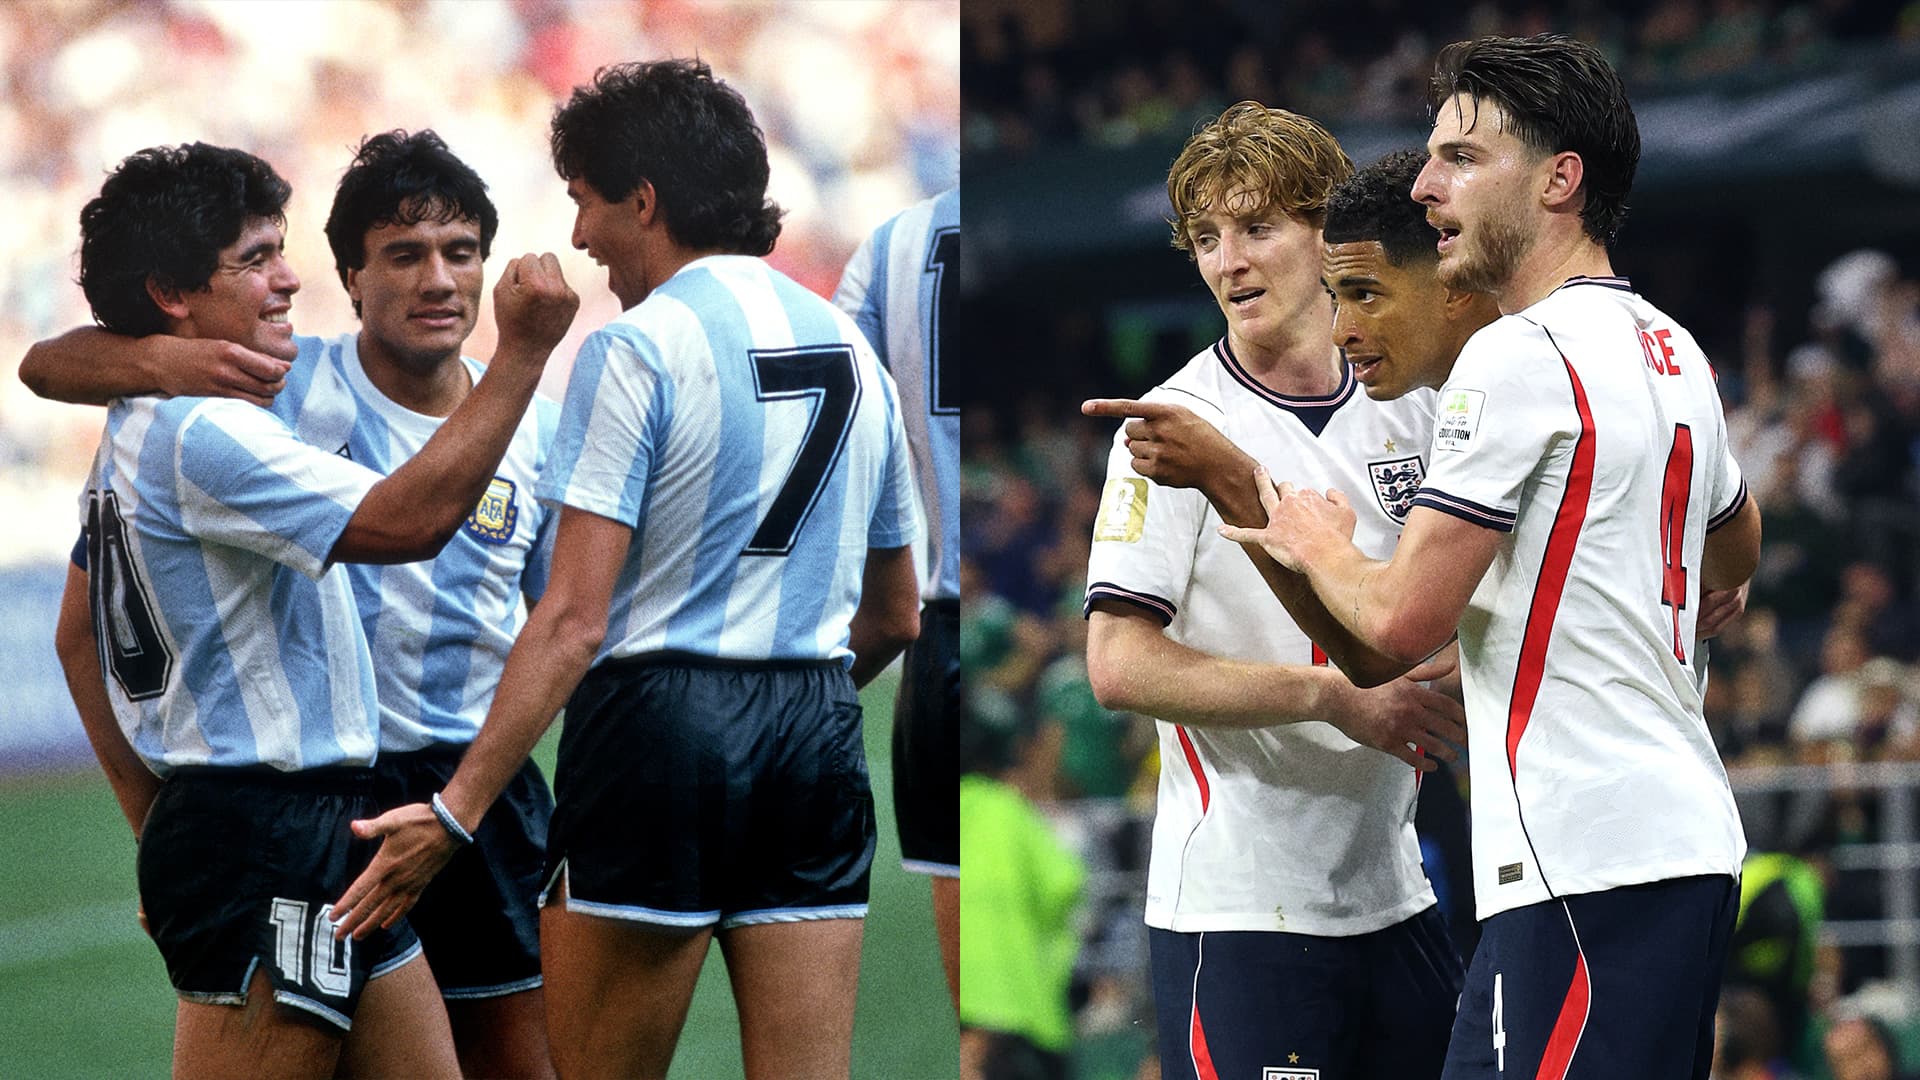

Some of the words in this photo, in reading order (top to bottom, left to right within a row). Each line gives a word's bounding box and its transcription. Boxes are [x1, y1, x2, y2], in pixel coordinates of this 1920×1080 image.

[480, 497, 503, 521] AFA
[739, 344, 863, 556] 7
[87, 489, 174, 703] 10
[1660, 423, 1693, 664] 4
[269, 896, 353, 999] 10
[1492, 972, 1506, 1072] 4
